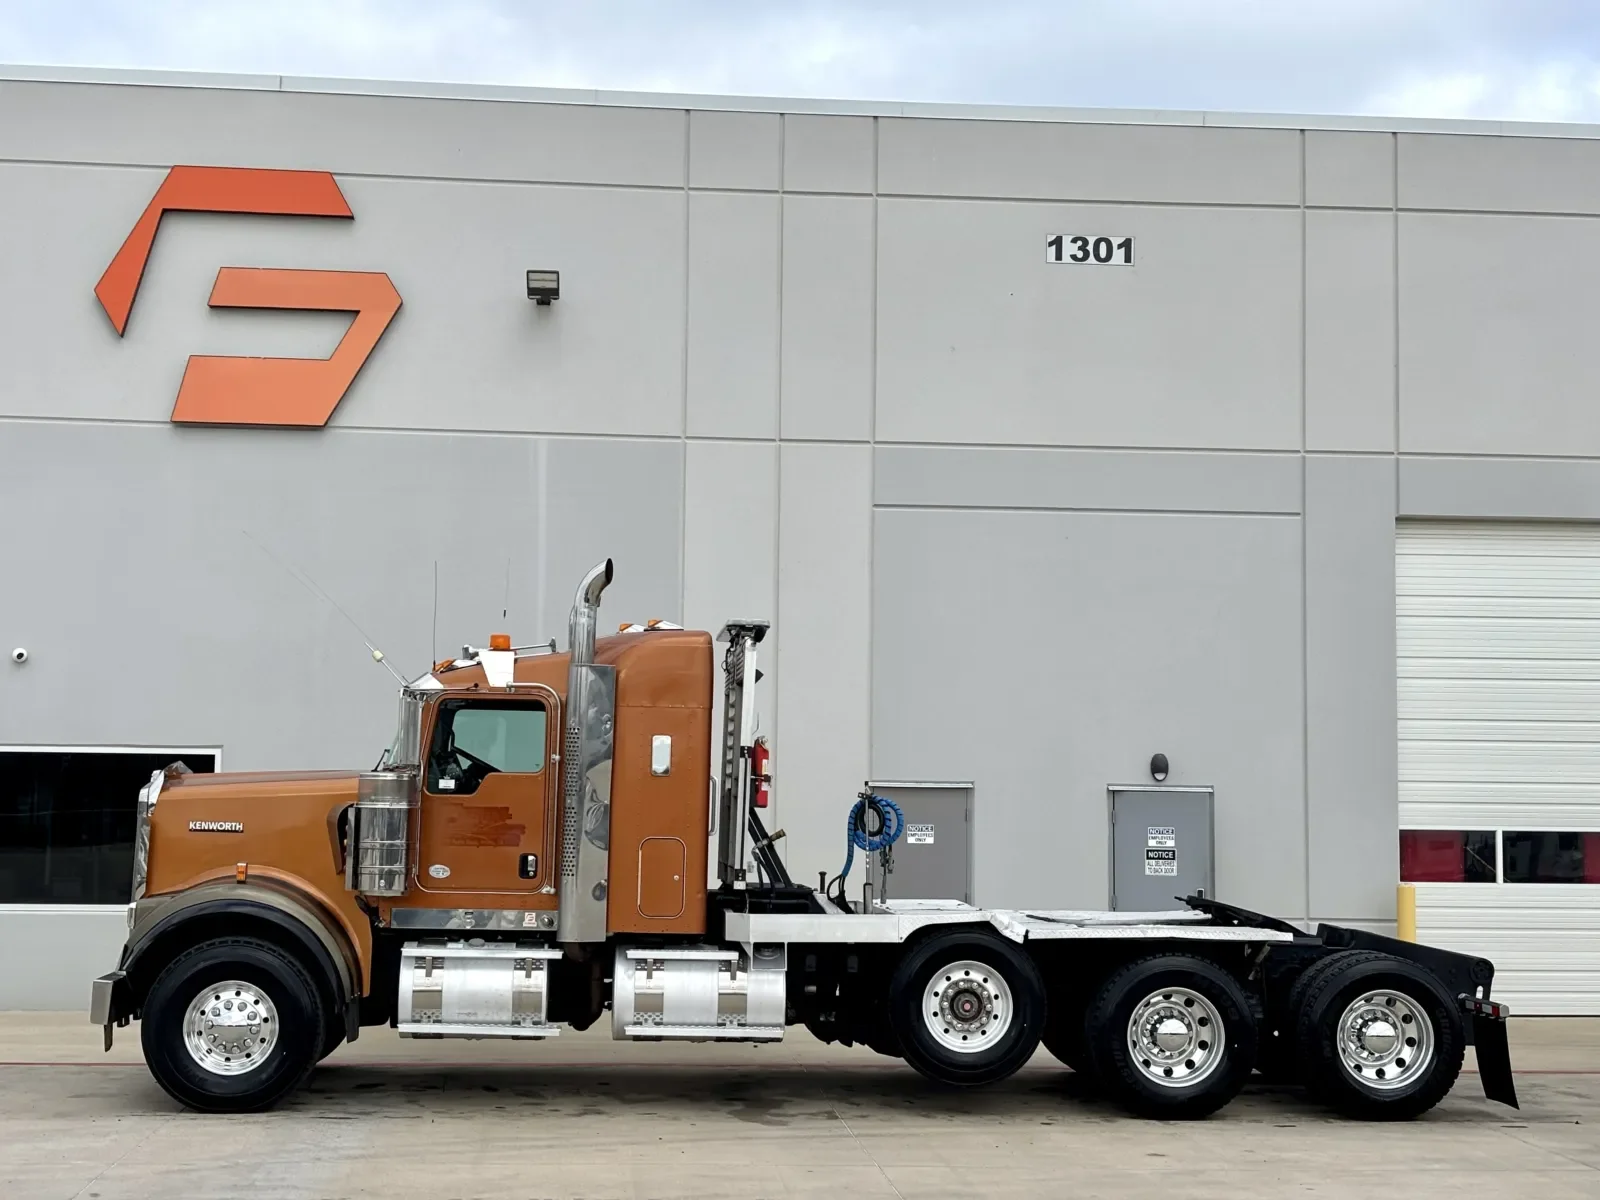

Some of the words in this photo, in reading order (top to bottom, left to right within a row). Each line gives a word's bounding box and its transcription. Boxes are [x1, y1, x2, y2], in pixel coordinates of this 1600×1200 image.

[1048, 235, 1132, 264] 1301
[189, 821, 243, 831] KENWORTH
[1148, 851, 1174, 859] NOTICE
